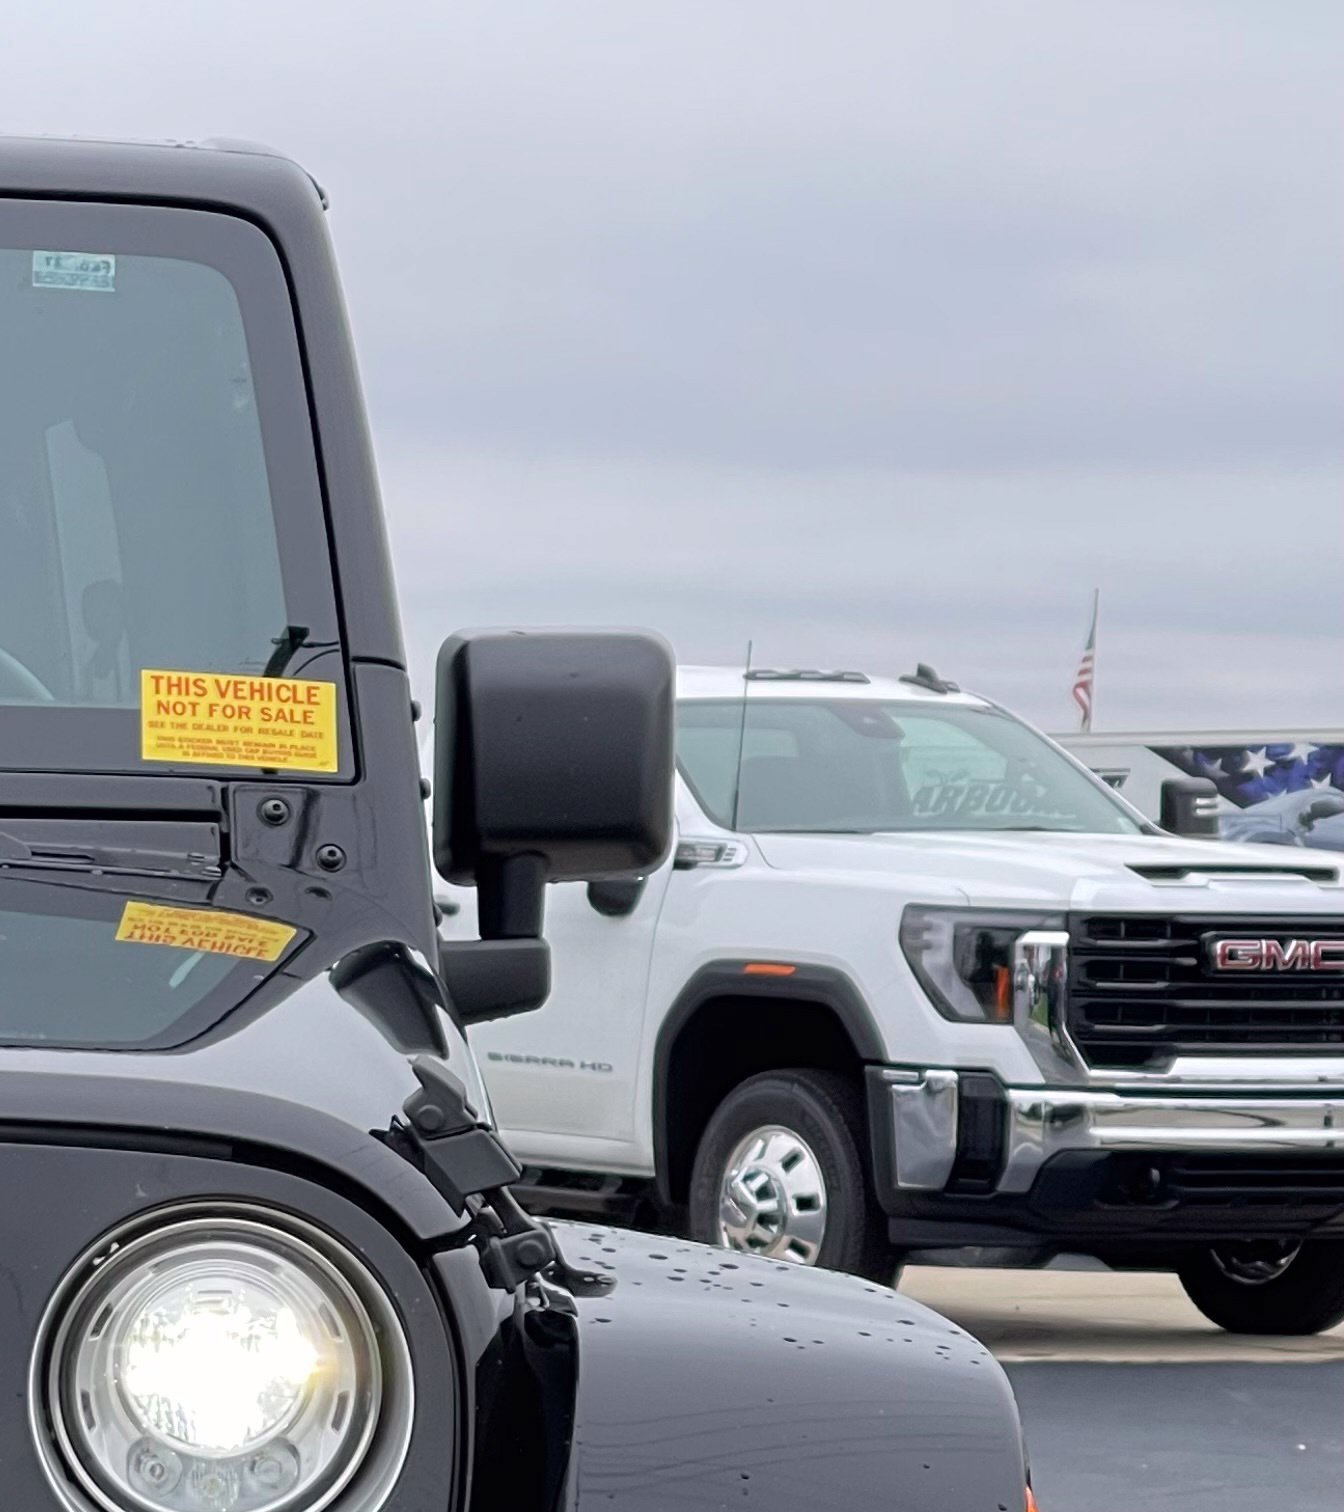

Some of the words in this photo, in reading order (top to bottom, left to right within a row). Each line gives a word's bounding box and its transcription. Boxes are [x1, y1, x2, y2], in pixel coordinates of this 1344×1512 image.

[150, 675, 208, 698] THIS
[214, 678, 321, 706] VEHICLE
[156, 699, 200, 717] NOT
[208, 703, 252, 720] FOR
[260, 706, 315, 726] SALE
[148, 721, 165, 730] SEE
[170, 721, 188, 731] THE
[191, 723, 229, 733] DEALER
[233, 726, 254, 735] FOR
[258, 727, 295, 738] RESALE
[301, 730, 325, 740] DATE
[1216, 939, 1344, 970] GMC
[487, 1051, 575, 1069] SIERRA
[579, 1059, 614, 1073] HD
